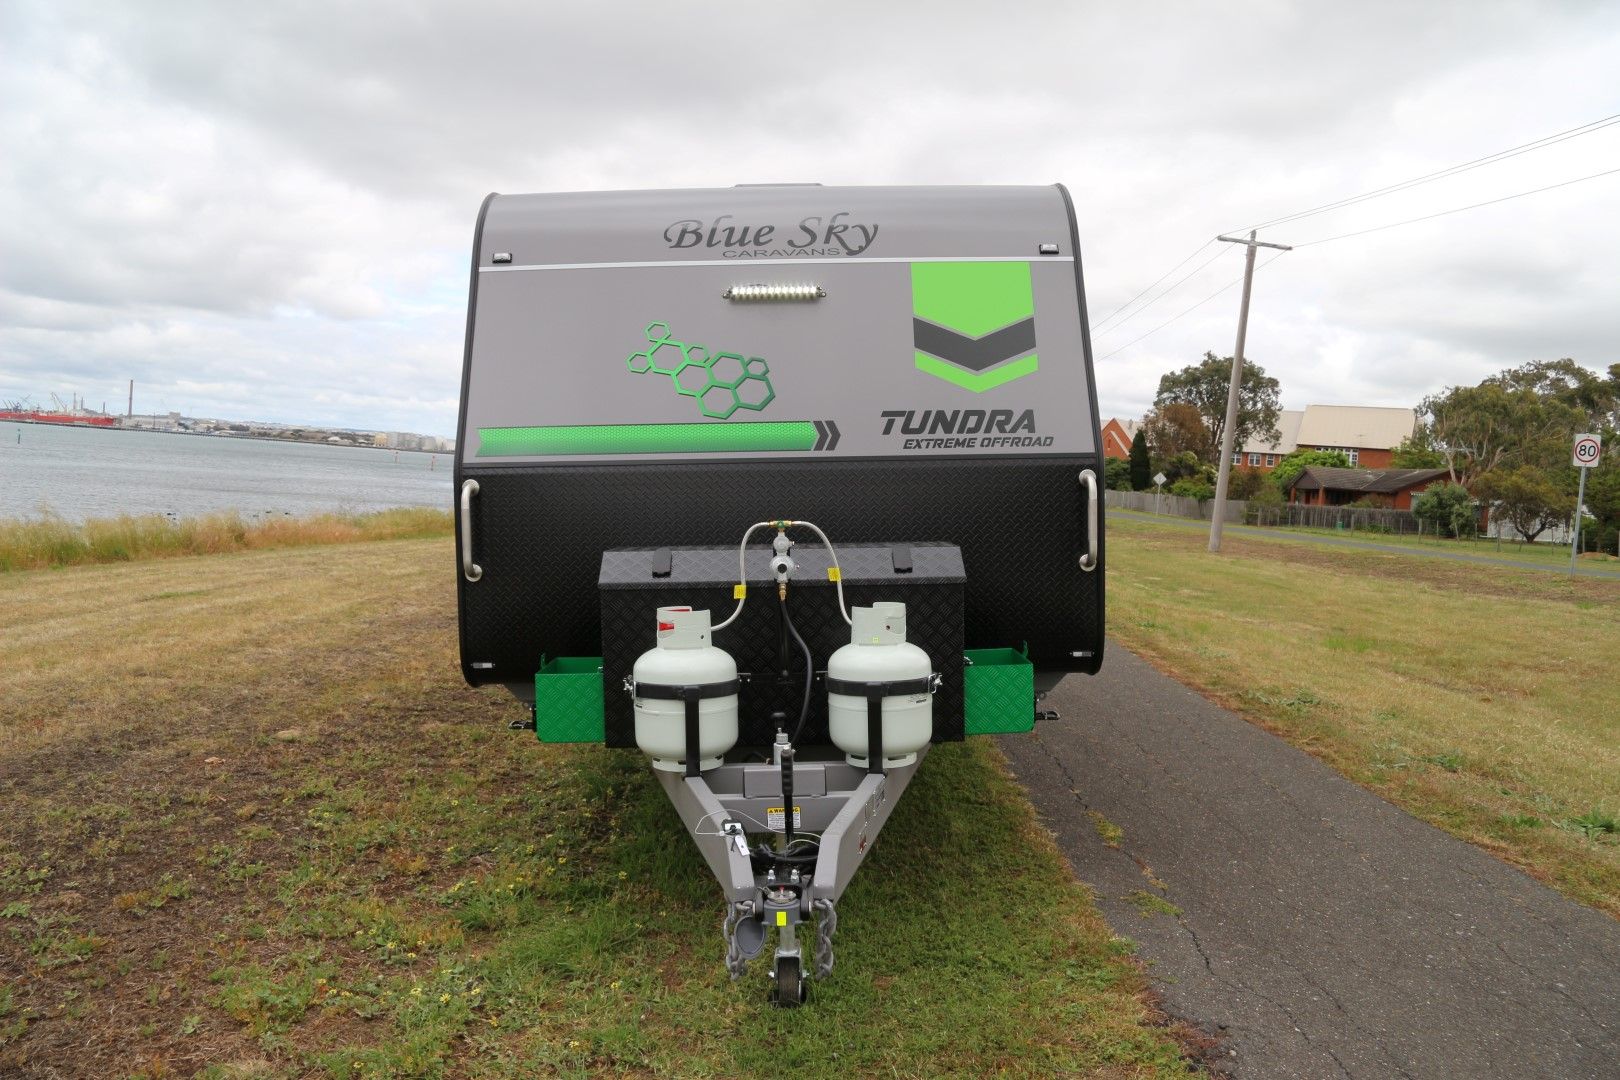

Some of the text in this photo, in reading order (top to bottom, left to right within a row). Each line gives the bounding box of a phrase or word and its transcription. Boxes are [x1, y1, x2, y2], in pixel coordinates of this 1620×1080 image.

[664, 212, 879, 256] Blue Sky
[722, 248, 841, 258] CARAVANS
[880, 409, 1036, 435] TUNDRA
[903, 436, 1054, 449] EXTREME OFFROAD
[1579, 445, 1596, 456] 80
